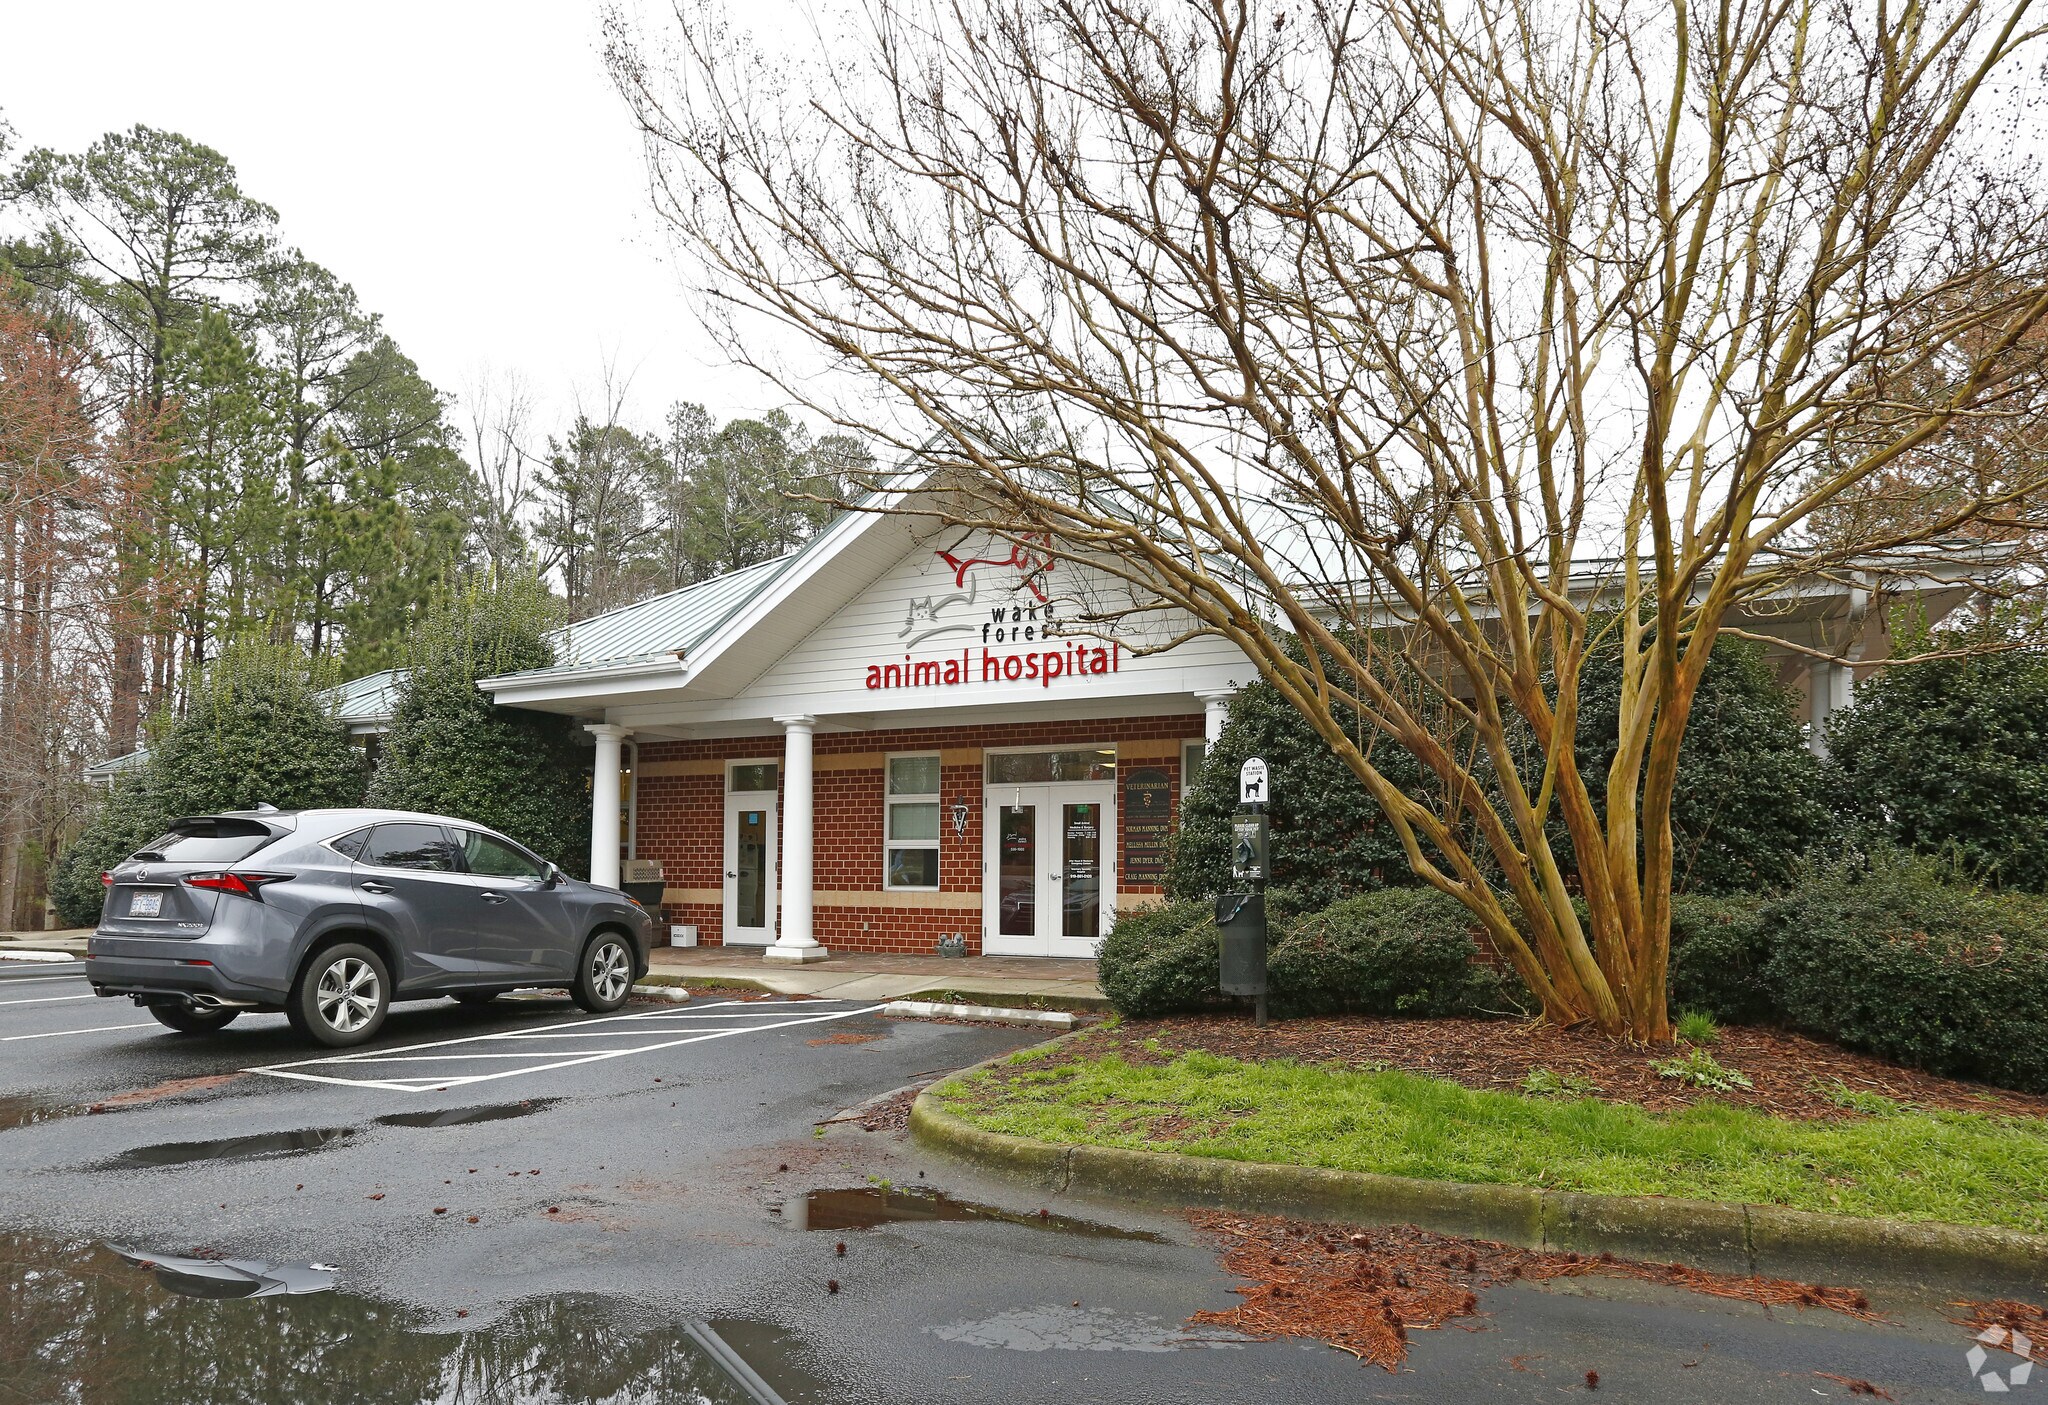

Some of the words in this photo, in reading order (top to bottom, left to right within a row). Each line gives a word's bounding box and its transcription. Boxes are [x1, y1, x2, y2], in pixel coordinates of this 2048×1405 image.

[991, 600, 1054, 623] wake
[865, 648, 969, 690] animal
[982, 641, 1119, 688] hospital
[1125, 782, 1169, 790] VETERINARIAN
